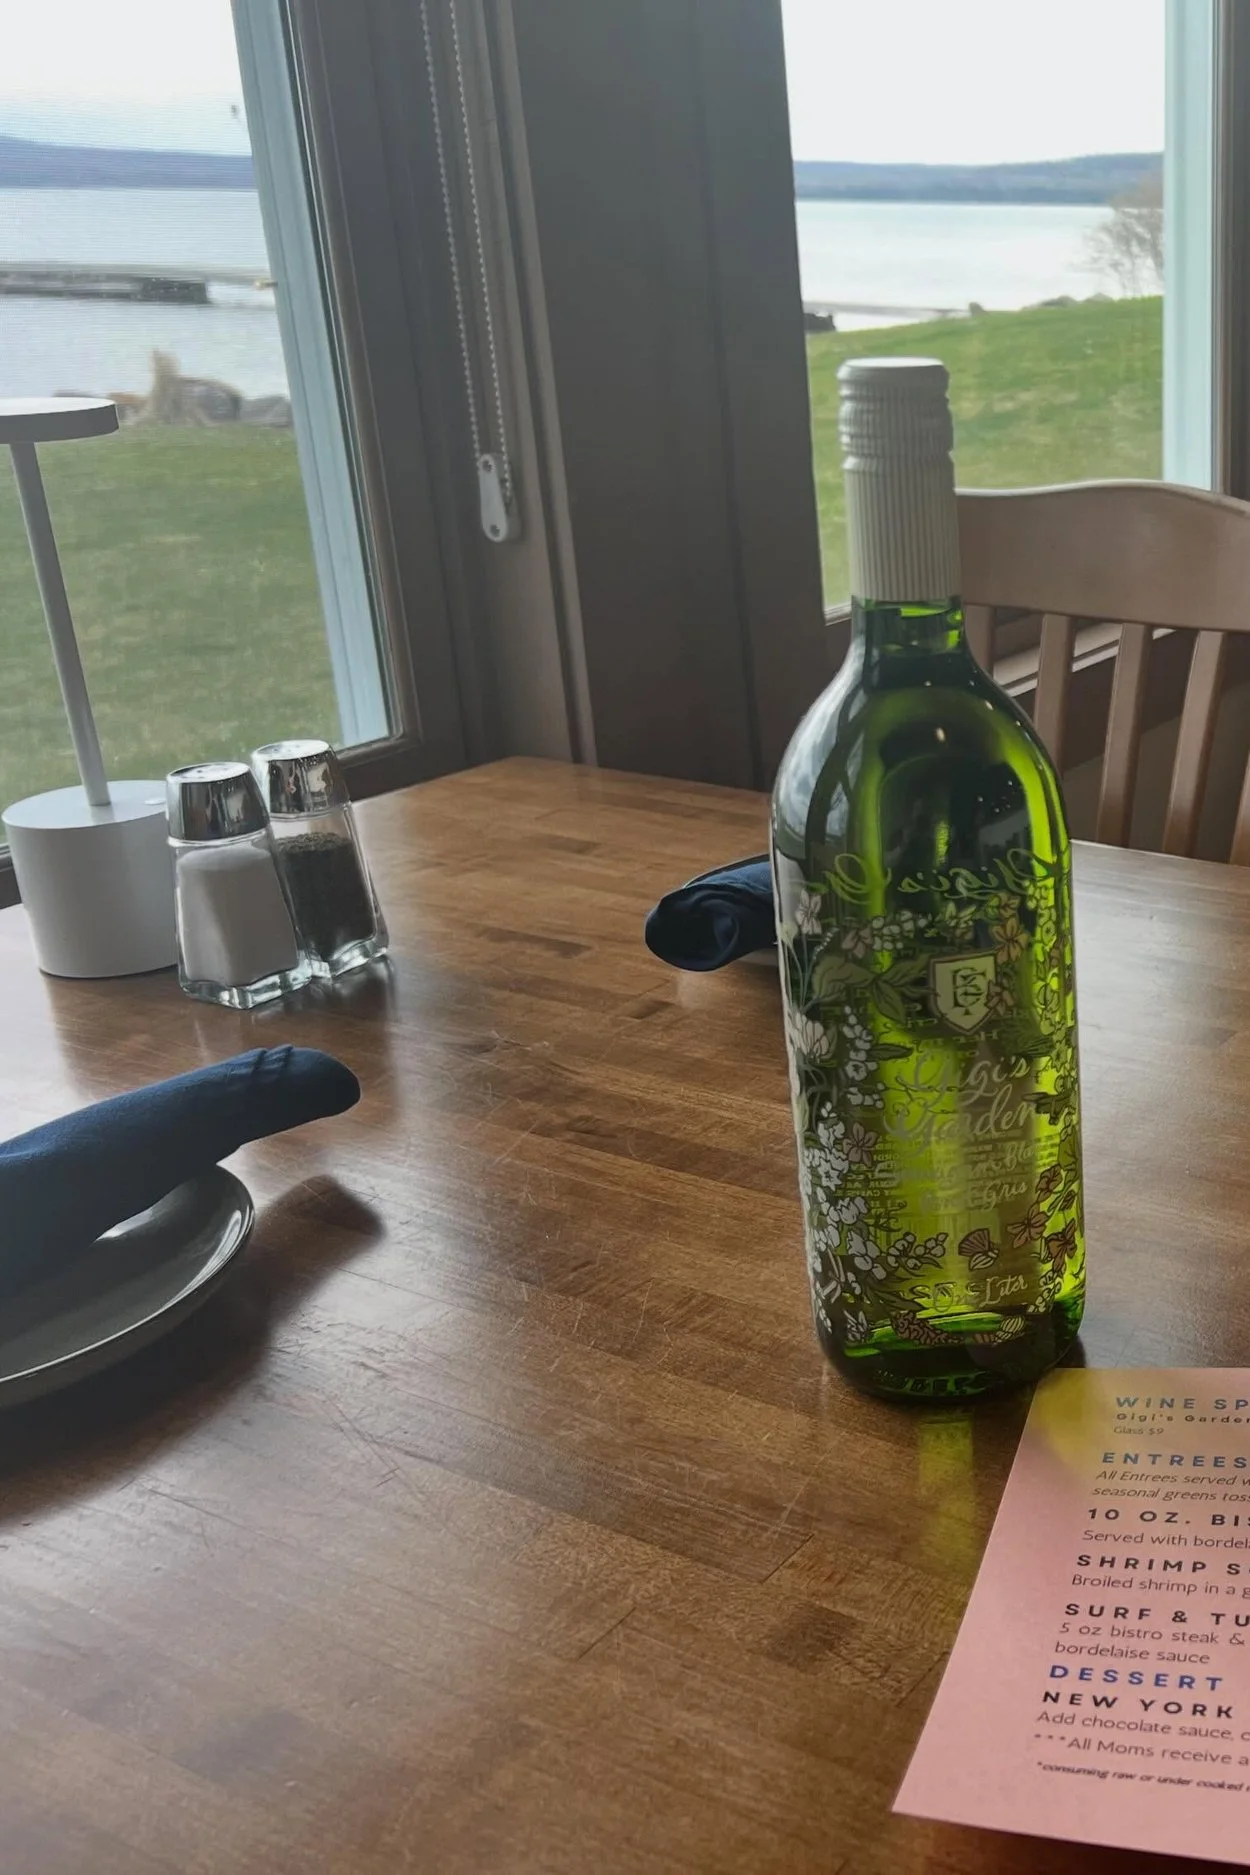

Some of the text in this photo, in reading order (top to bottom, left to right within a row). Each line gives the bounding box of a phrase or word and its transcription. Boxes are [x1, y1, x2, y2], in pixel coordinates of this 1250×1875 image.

[979, 1275, 1028, 1307] Liter
[1116, 1397, 1195, 1409] WINE
[1102, 1452, 1248, 1468] ENTREES
[1096, 1470, 1117, 1480] All
[1120, 1471, 1178, 1483] Entrees
[1183, 1475, 1237, 1486] served
[1092, 1486, 1160, 1498] seasonal
[1162, 1490, 1217, 1501] greens
[1088, 1508, 1120, 1520] 10
[1139, 1511, 1191, 1524] OZ.
[1082, 1529, 1144, 1544] Served
[1151, 1533, 1188, 1546] with
[1076, 1554, 1207, 1573] SHRIMP
[1072, 1573, 1133, 1589] Broiled
[1139, 1578, 1198, 1596] shrimp
[1204, 1582, 1219, 1594] in
[1225, 1585, 1236, 1596] a
[1065, 1603, 1152, 1620] SURF
[1171, 1610, 1188, 1623] &
[1059, 1622, 1071, 1634] 5
[1078, 1625, 1102, 1636] oz
[1110, 1624, 1163, 1641] bistro
[1171, 1629, 1220, 1645] steak
[1229, 1632, 1245, 1646] &
[1055, 1641, 1211, 1664] bordelaise sauce
[1050, 1664, 1223, 1691] DESSERT
[1042, 1691, 1118, 1708] NEW
[1139, 1698, 1233, 1719] YORK
[1036, 1710, 1076, 1726] Add
[1081, 1715, 1171, 1734] chocolate
[1097, 1740, 1154, 1758] Moms
[1162, 1748, 1232, 1766] receive
[1238, 1755, 1249, 1766] a
[1112, 1771, 1136, 1780] raw
[1140, 1773, 1154, 1781] or
[1157, 1774, 1192, 1787] under
[1196, 1779, 1243, 1792] cooked
